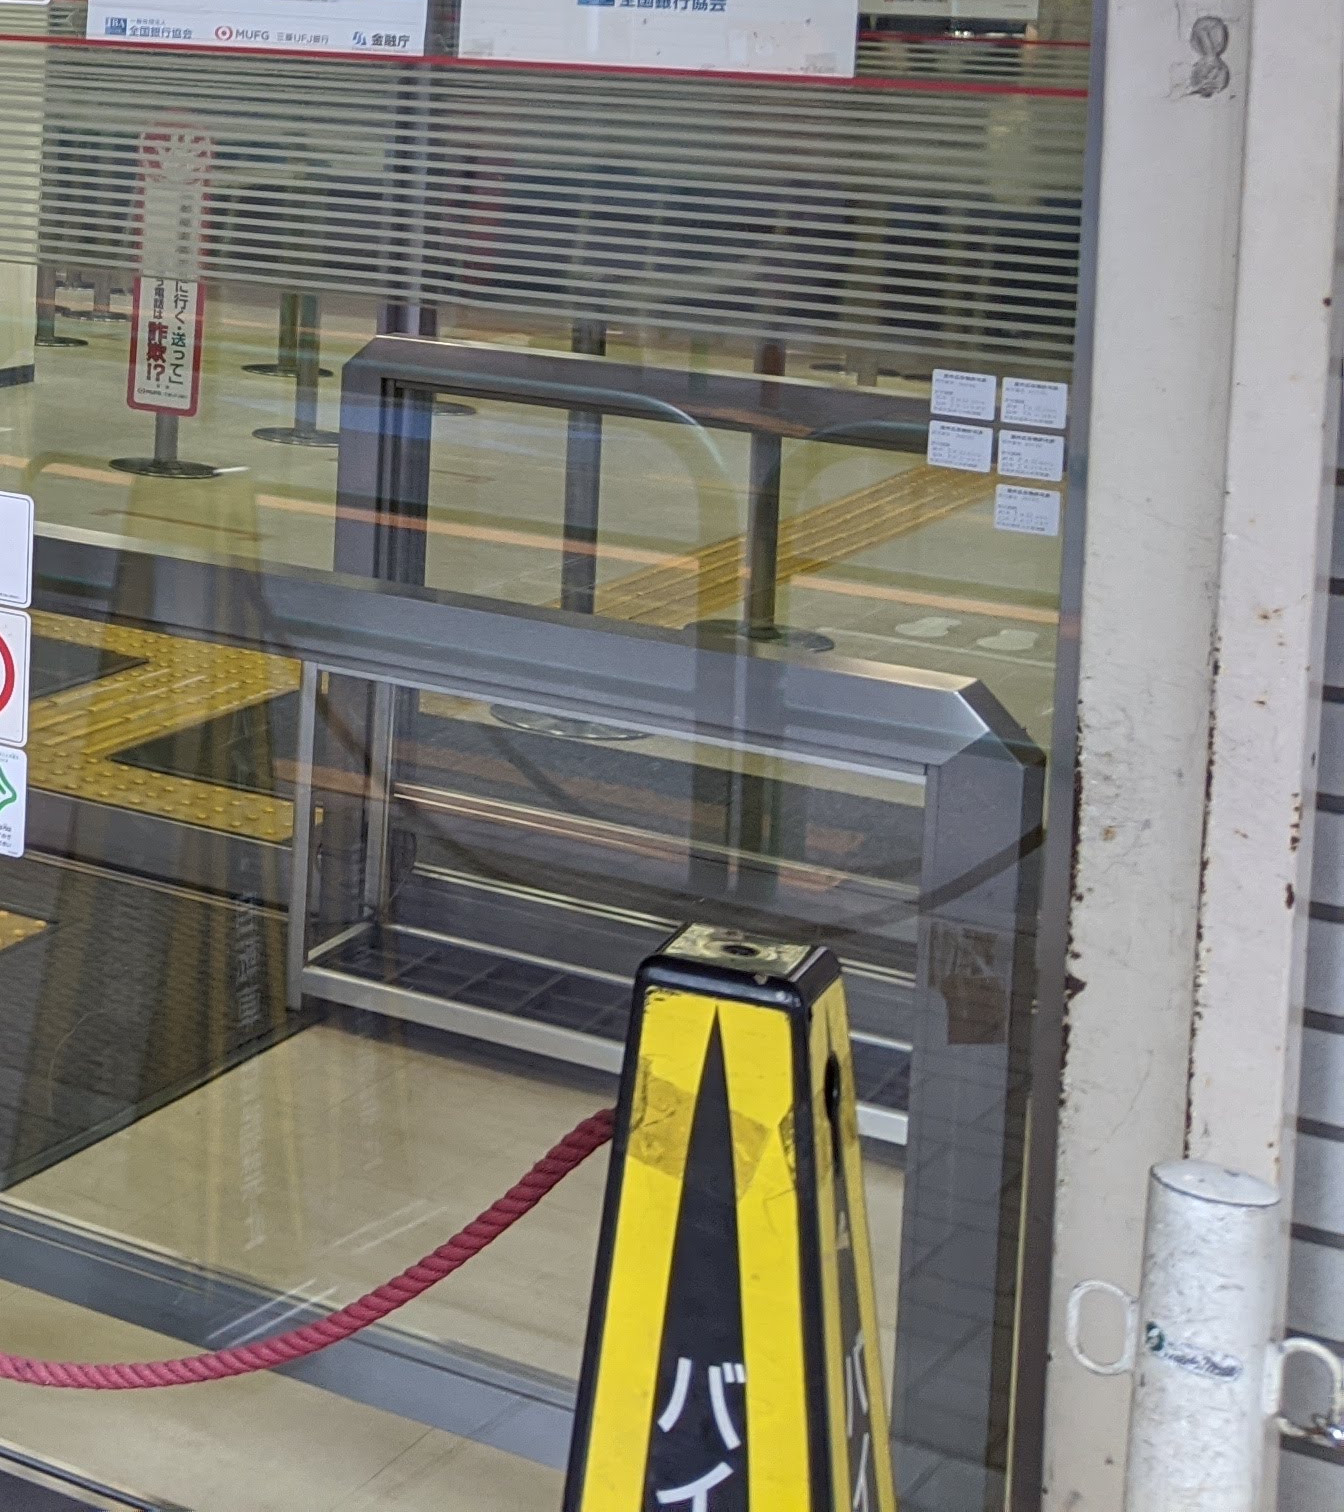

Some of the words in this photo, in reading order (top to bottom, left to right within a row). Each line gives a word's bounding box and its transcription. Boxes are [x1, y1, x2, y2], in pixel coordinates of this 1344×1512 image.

[129, 25, 193, 40] 全国銀行協会
[235, 29, 270, 41] MUFG
[372, 32, 410, 48] 金融庁
